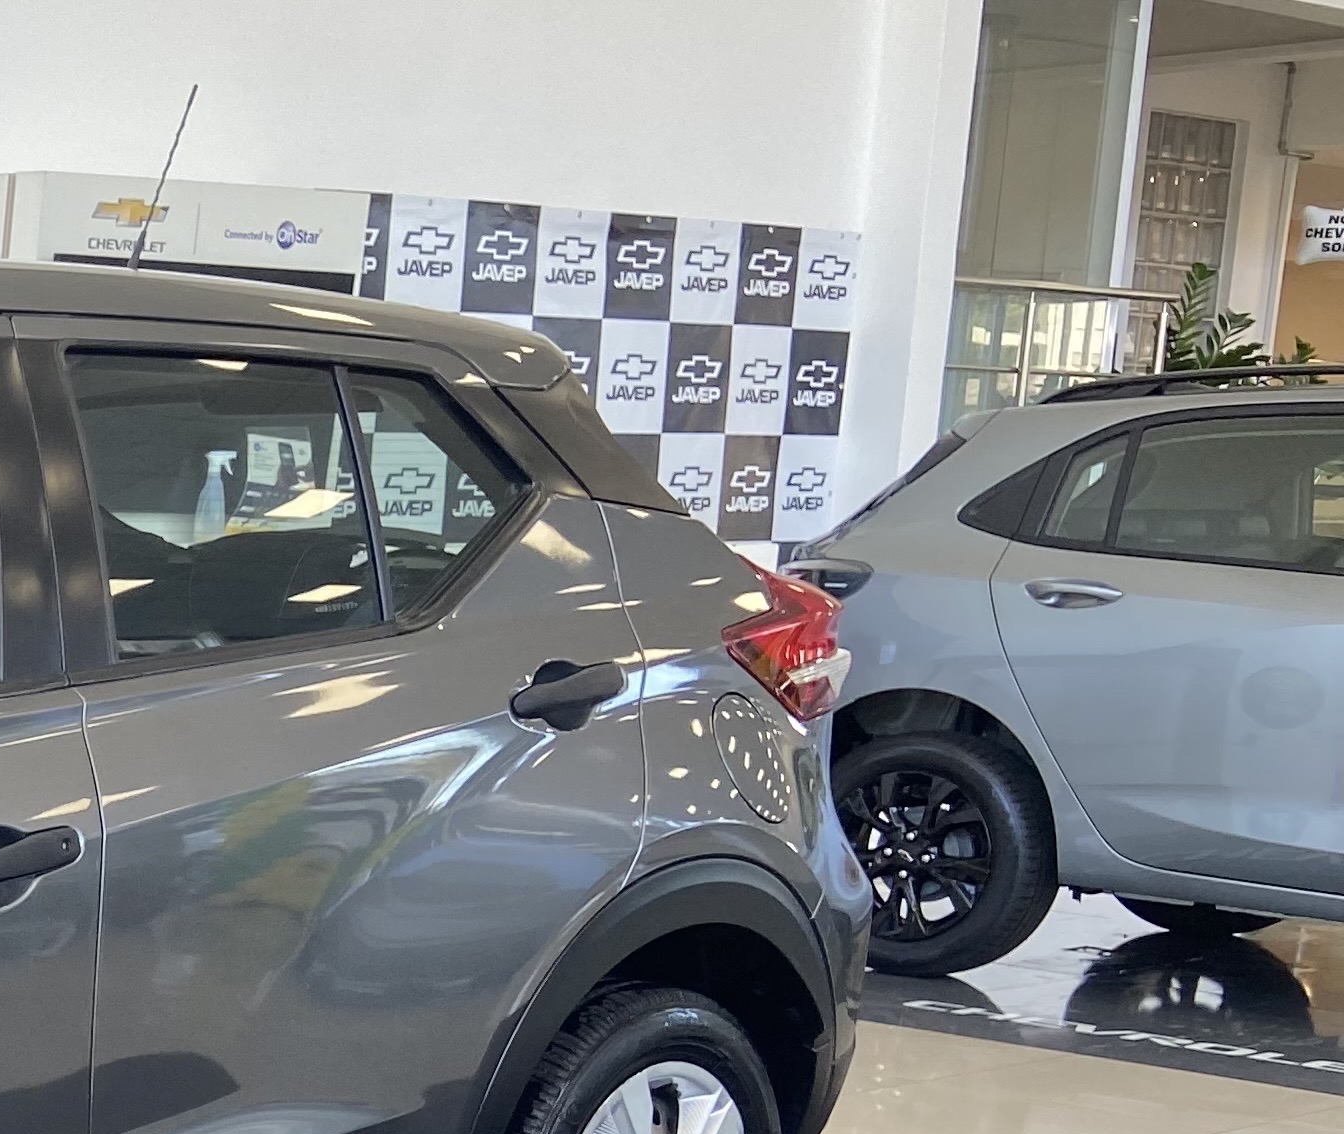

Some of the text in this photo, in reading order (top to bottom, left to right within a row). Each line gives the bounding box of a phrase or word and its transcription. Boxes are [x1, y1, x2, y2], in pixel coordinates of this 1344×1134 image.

[224, 228, 263, 241] Connected
[264, 230, 274, 243] by
[87, 237, 166, 253] CHEVRLET
[397, 259, 453, 277] JAVEP
[472, 263, 527, 282] JAVEP
[545, 268, 596, 285] JAVEP
[613, 272, 664, 290] JAVEP
[681, 276, 728, 292] JAVEP
[743, 279, 790, 298] JAVEP
[803, 284, 847, 300] JAVEP
[606, 384, 655, 401] JAVEP
[672, 385, 720, 404] JAVEP
[735, 388, 779, 404] JAVEP
[792, 390, 837, 408] JAVEP
[379, 500, 433, 516] JAVEP
[451, 499, 497, 517] JAVE
[725, 495, 769, 513] JAVEP
[782, 496, 823, 511] JAVEP
